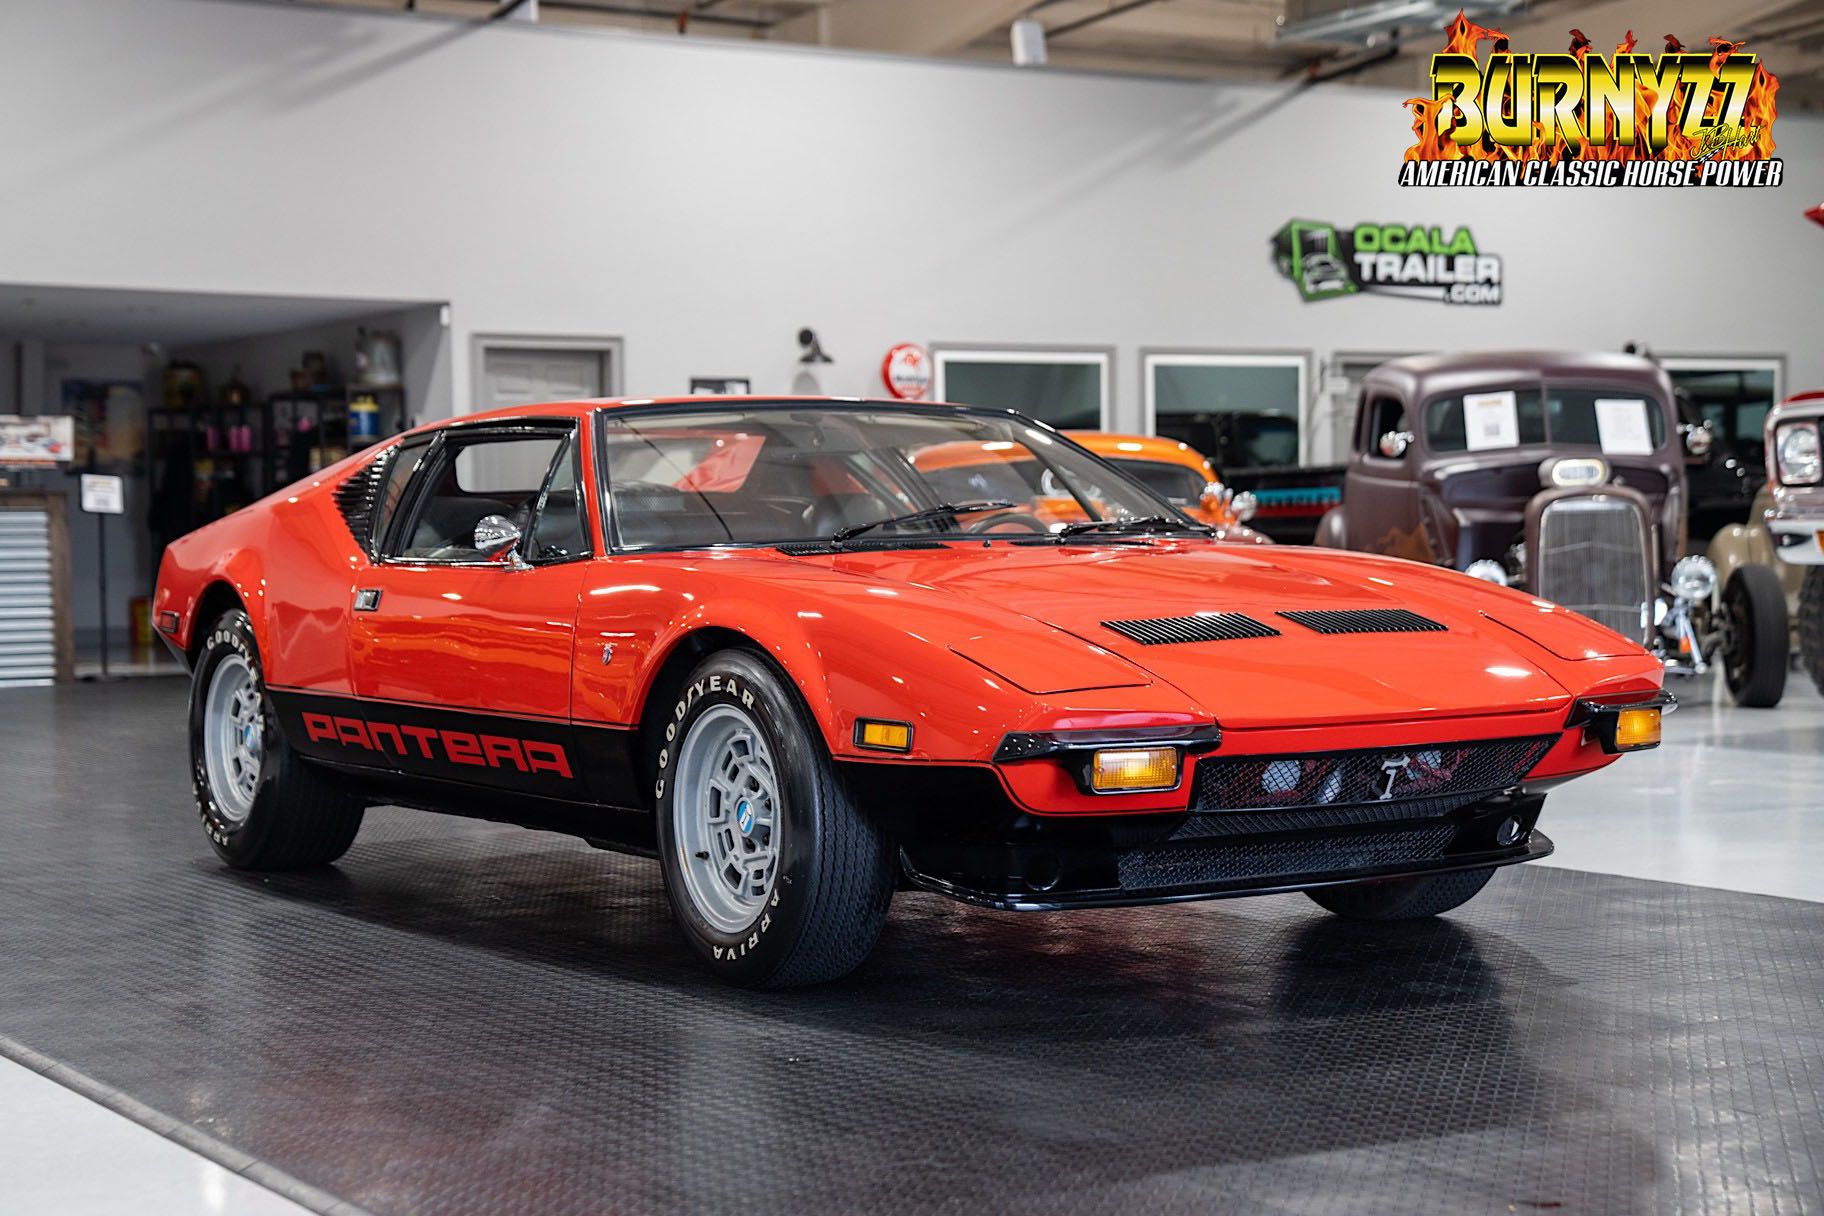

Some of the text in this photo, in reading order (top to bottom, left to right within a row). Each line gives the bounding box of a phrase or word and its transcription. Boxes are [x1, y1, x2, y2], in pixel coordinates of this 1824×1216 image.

[1353, 222, 1475, 255] OCALA
[1353, 252, 1500, 283] TRAILER
[1444, 283, 1500, 304] .COM
[302, 711, 573, 779] PANTERA
[655, 675, 754, 799] GOODYEAR
[712, 888, 780, 961] ARRIVA
